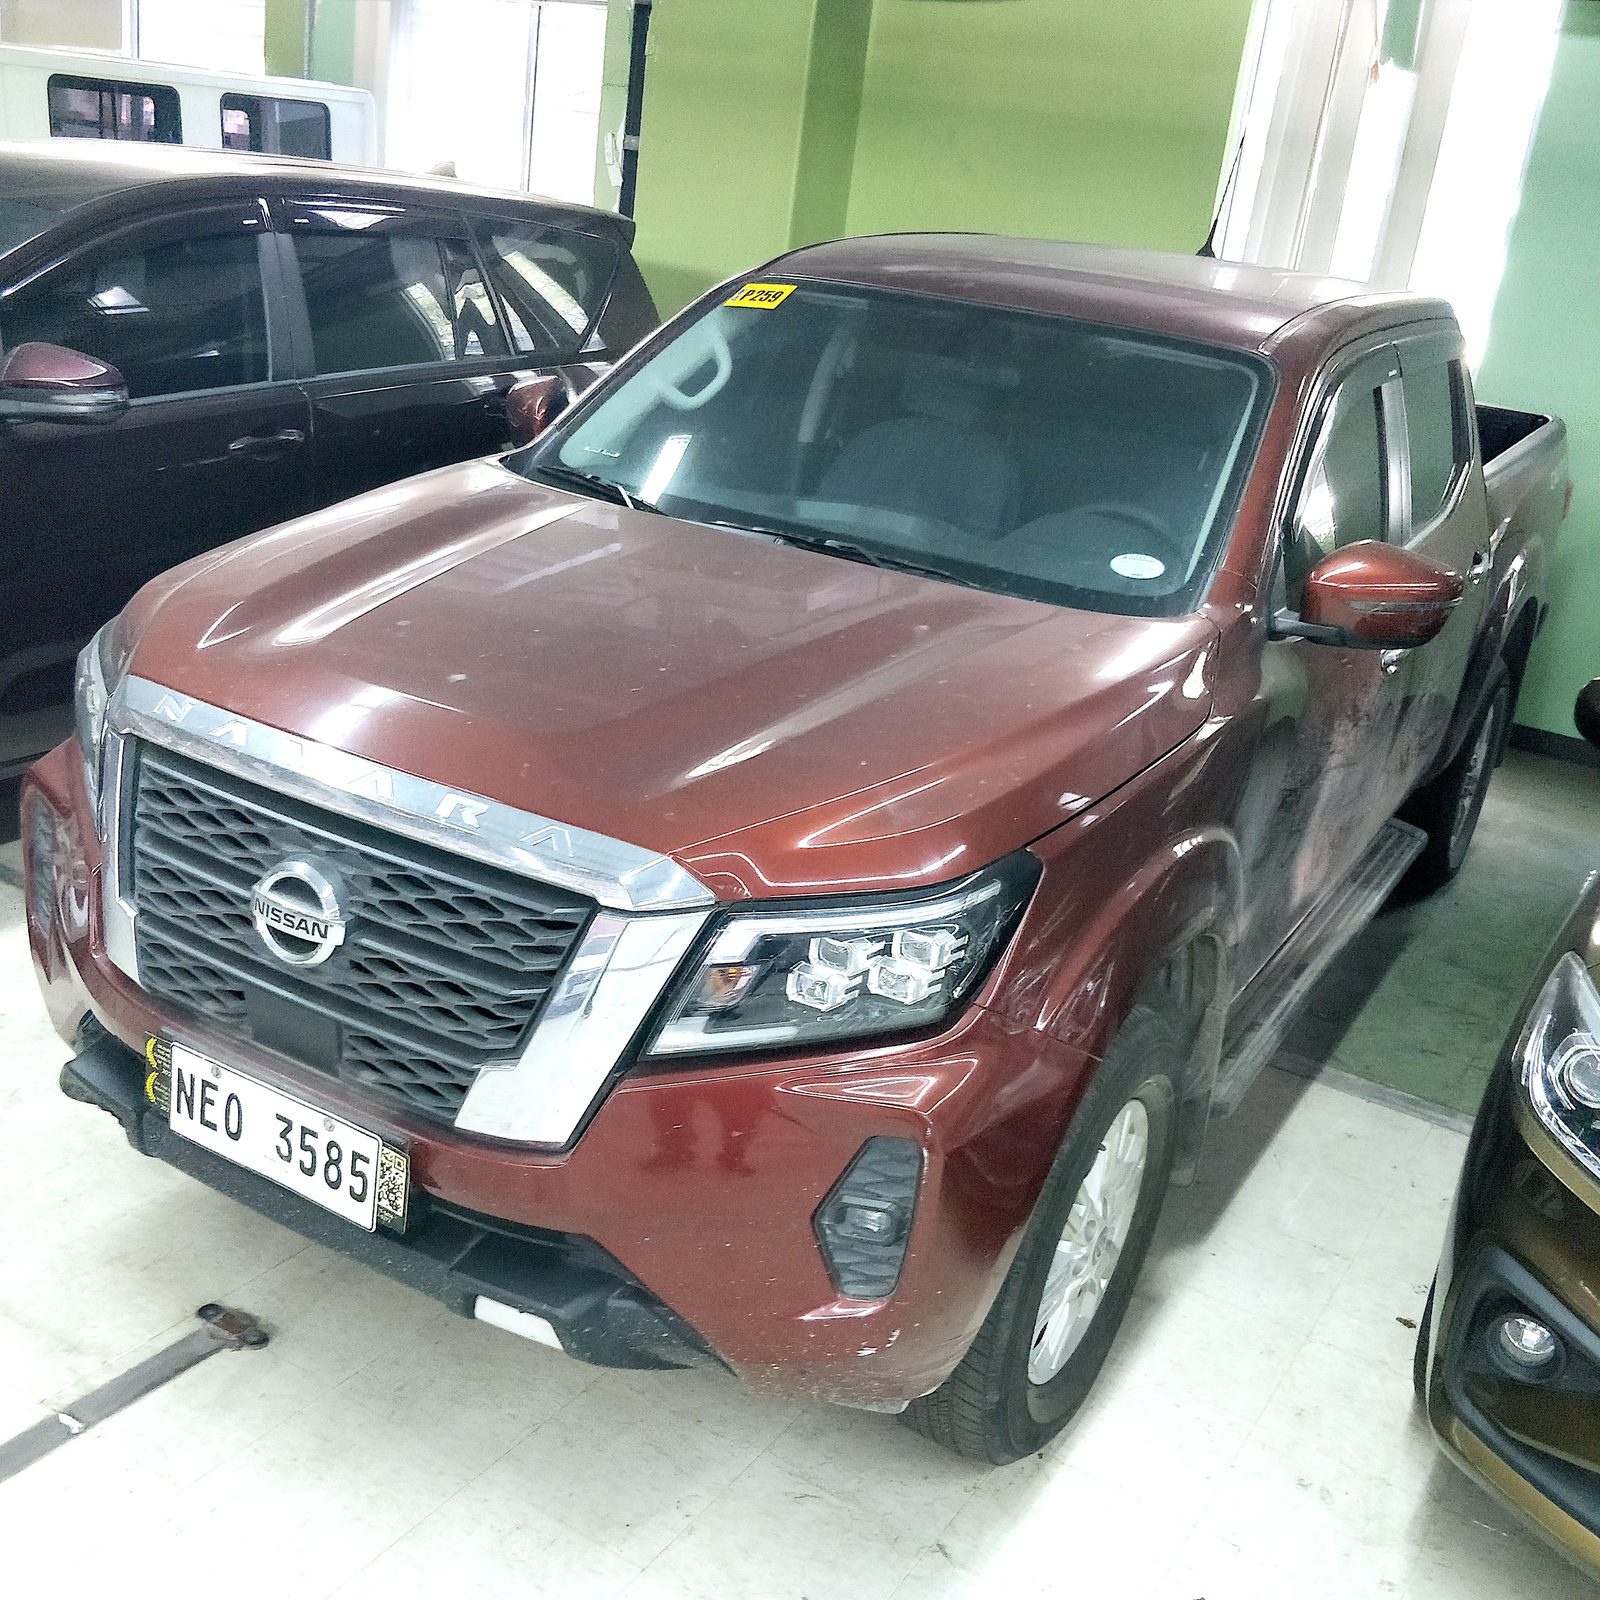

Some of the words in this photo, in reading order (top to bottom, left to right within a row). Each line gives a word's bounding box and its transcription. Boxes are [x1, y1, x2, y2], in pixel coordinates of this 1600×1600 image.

[254, 897, 329, 939] NISSAN
[176, 1067, 243, 1142] NEO
[275, 1113, 370, 1203] 3585
